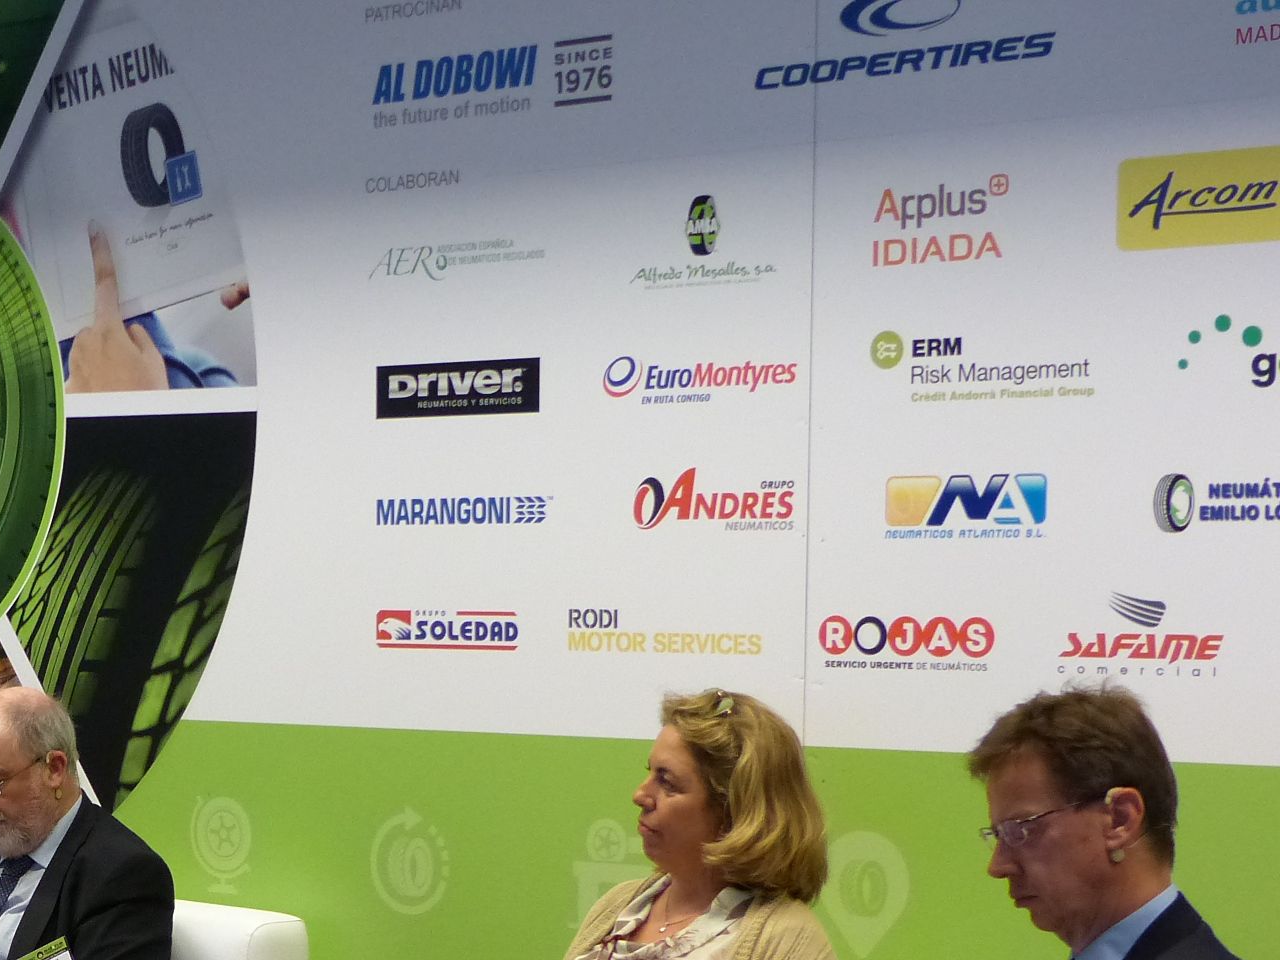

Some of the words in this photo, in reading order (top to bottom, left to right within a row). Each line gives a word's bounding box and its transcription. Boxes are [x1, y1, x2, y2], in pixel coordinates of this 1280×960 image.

[1235, 23, 1280, 45] MAD
[554, 47, 613, 66] SINCE
[755, 32, 1056, 90] COOPERTIRES
[372, 62, 405, 105] AL
[412, 44, 538, 100] DOBOWI
[554, 65, 613, 94] 1976
[373, 111, 397, 129] the
[402, 107, 449, 126] future
[453, 100, 470, 119] of
[474, 96, 530, 117] motion
[365, 169, 460, 194] COLABORAN
[1128, 171, 1279, 229] Arcom
[872, 232, 1003, 267] IDIADA
[911, 337, 962, 358] ERM
[644, 361, 797, 392] EuroMontyres
[911, 365, 951, 384] Risk
[958, 358, 1090, 385] Management
[1251, 353, 1280, 388] g
[479, 396, 523, 406] SERVICIOS
[641, 396, 652, 405] EN
[654, 395, 674, 404] RUTA
[676, 393, 711, 403] CONTIGO
[1000, 388, 1053, 399] Financial
[1058, 386, 1095, 398] Group
[760, 480, 795, 489] GRUPO
[376, 496, 511, 526] MARANGONI
[1199, 504, 1260, 521] EMILIO
[414, 620, 519, 642] SOLEDAD
[568, 608, 619, 630] RODI
[568, 631, 646, 654] MOTOR
[652, 632, 763, 656] SERVICES
[823, 616, 990, 656] ROJAS
[1058, 632, 1224, 665] SAFAME
[825, 660, 867, 669] SERVICIO
[869, 661, 914, 670] URGENTE
[916, 662, 927, 670] DE
[1057, 665, 1217, 677] comercial
